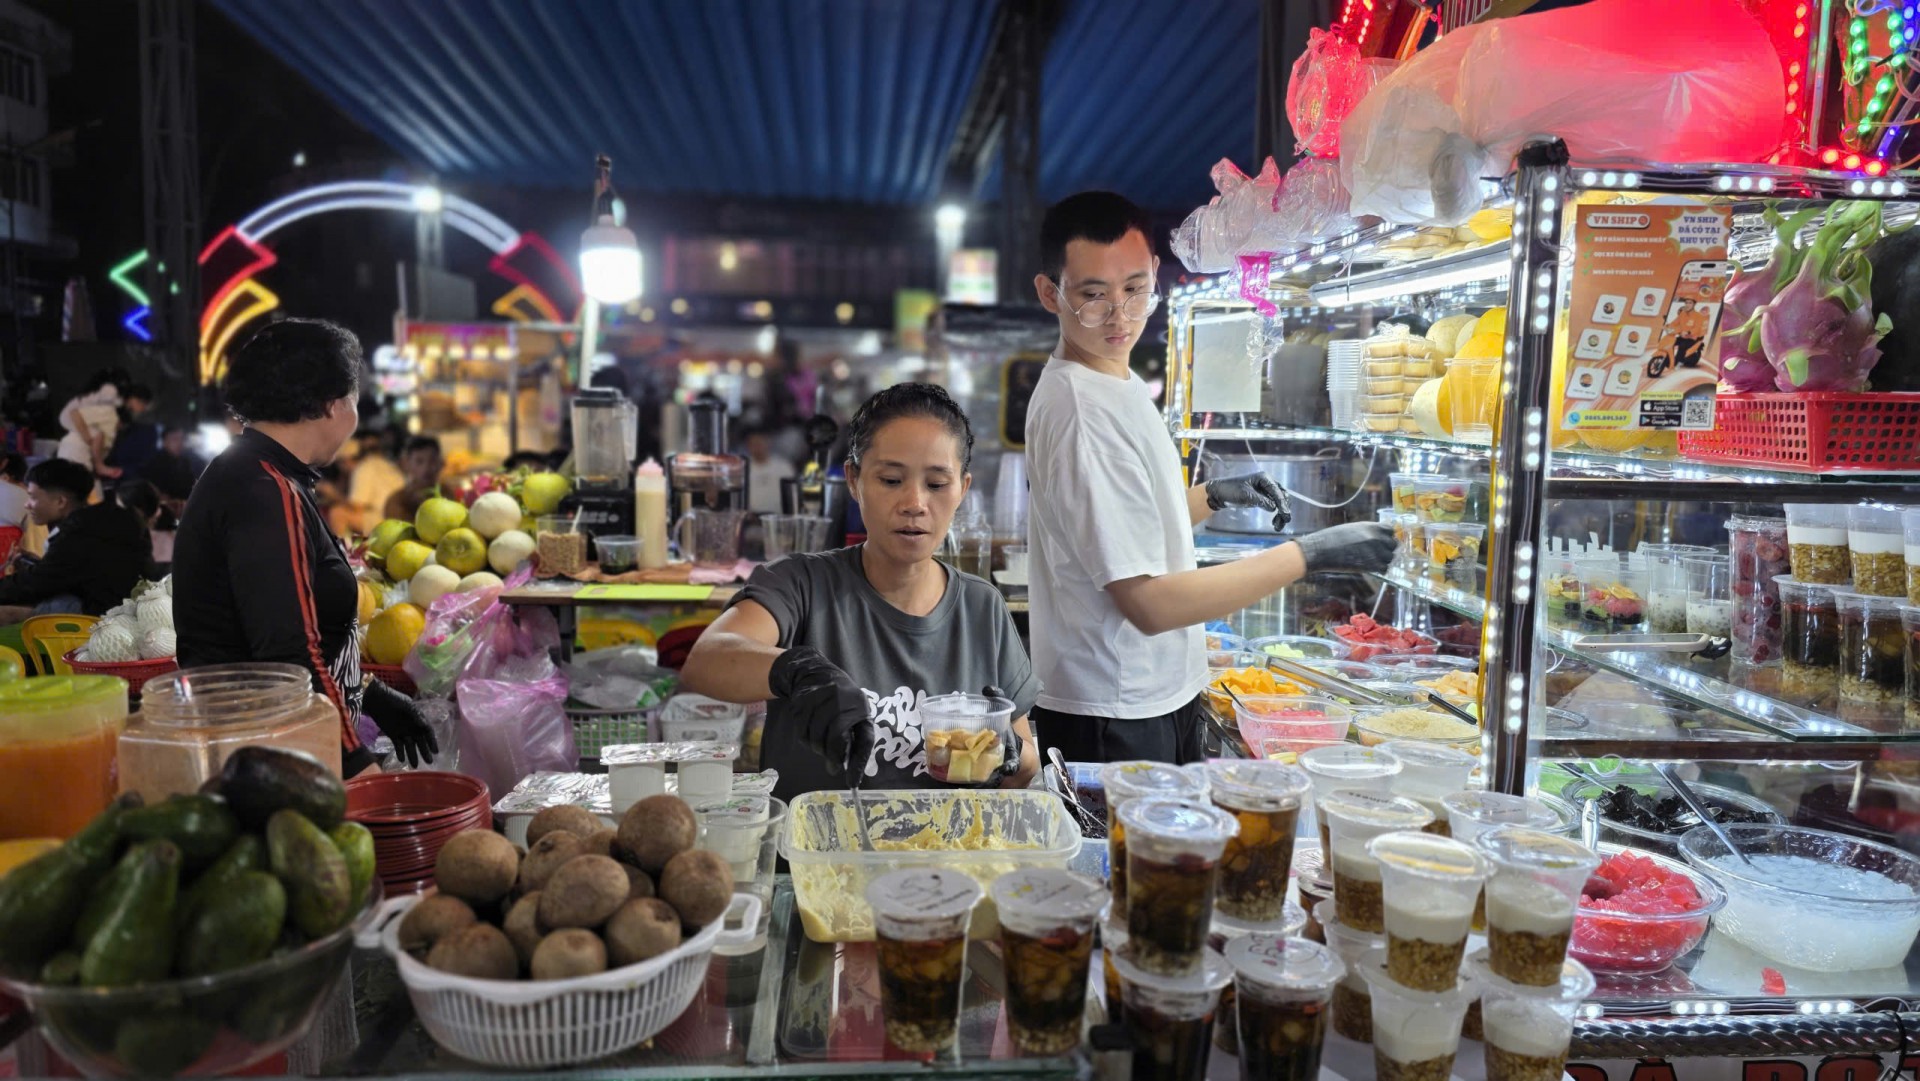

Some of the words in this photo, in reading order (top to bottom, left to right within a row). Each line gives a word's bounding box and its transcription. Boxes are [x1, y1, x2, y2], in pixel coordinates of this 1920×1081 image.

[1593, 216, 1610, 224] VN
[1611, 216, 1637, 225] SHIP
[1692, 225, 1704, 234] CÓ
[1699, 236, 1718, 245] VỰC
[1651, 418, 1668, 426] Google
[1669, 418, 1679, 426] Play
